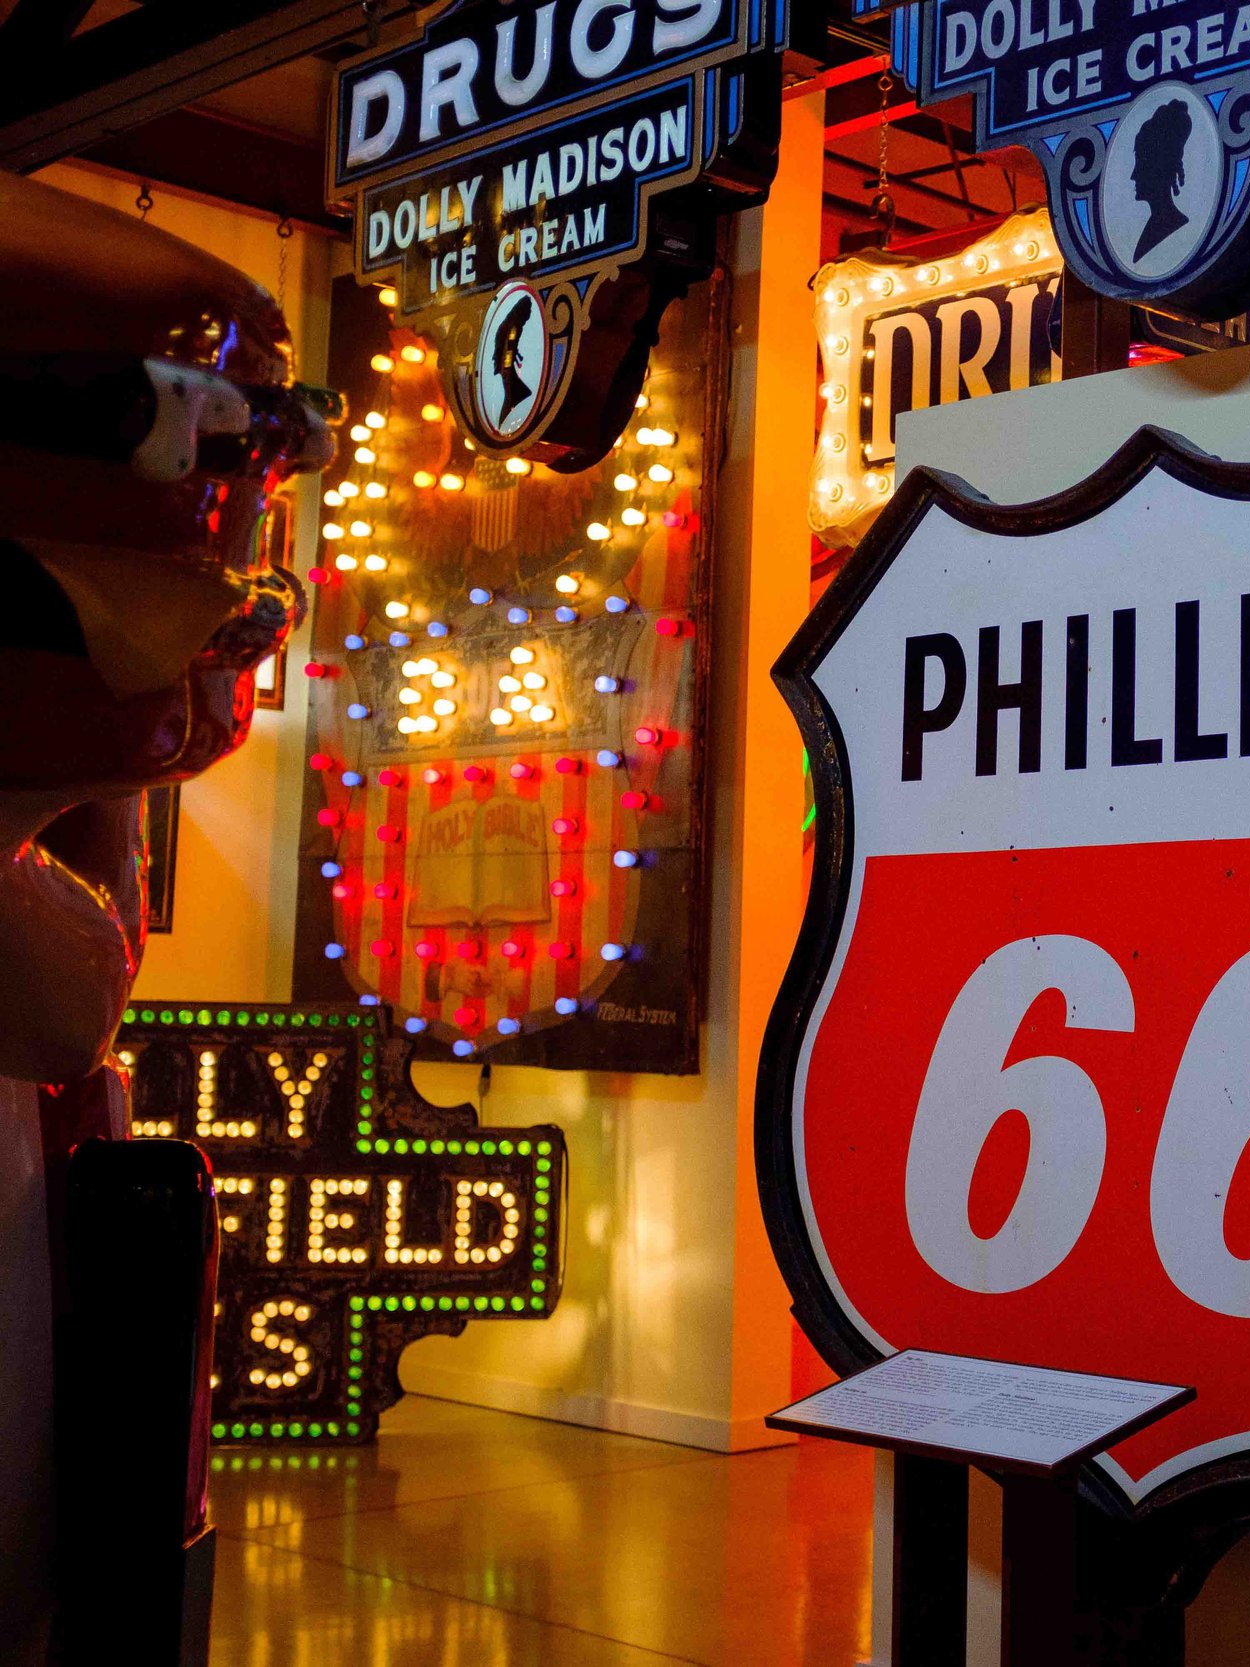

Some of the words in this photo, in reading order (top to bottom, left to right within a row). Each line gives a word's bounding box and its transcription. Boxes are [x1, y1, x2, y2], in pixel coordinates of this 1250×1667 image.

[1026, 48, 1102, 112] ICE
[368, 175, 483, 260] DOLLY
[502, 105, 687, 214] MADISON
[430, 245, 477, 294] ICE
[498, 203, 607, 272] CREAM
